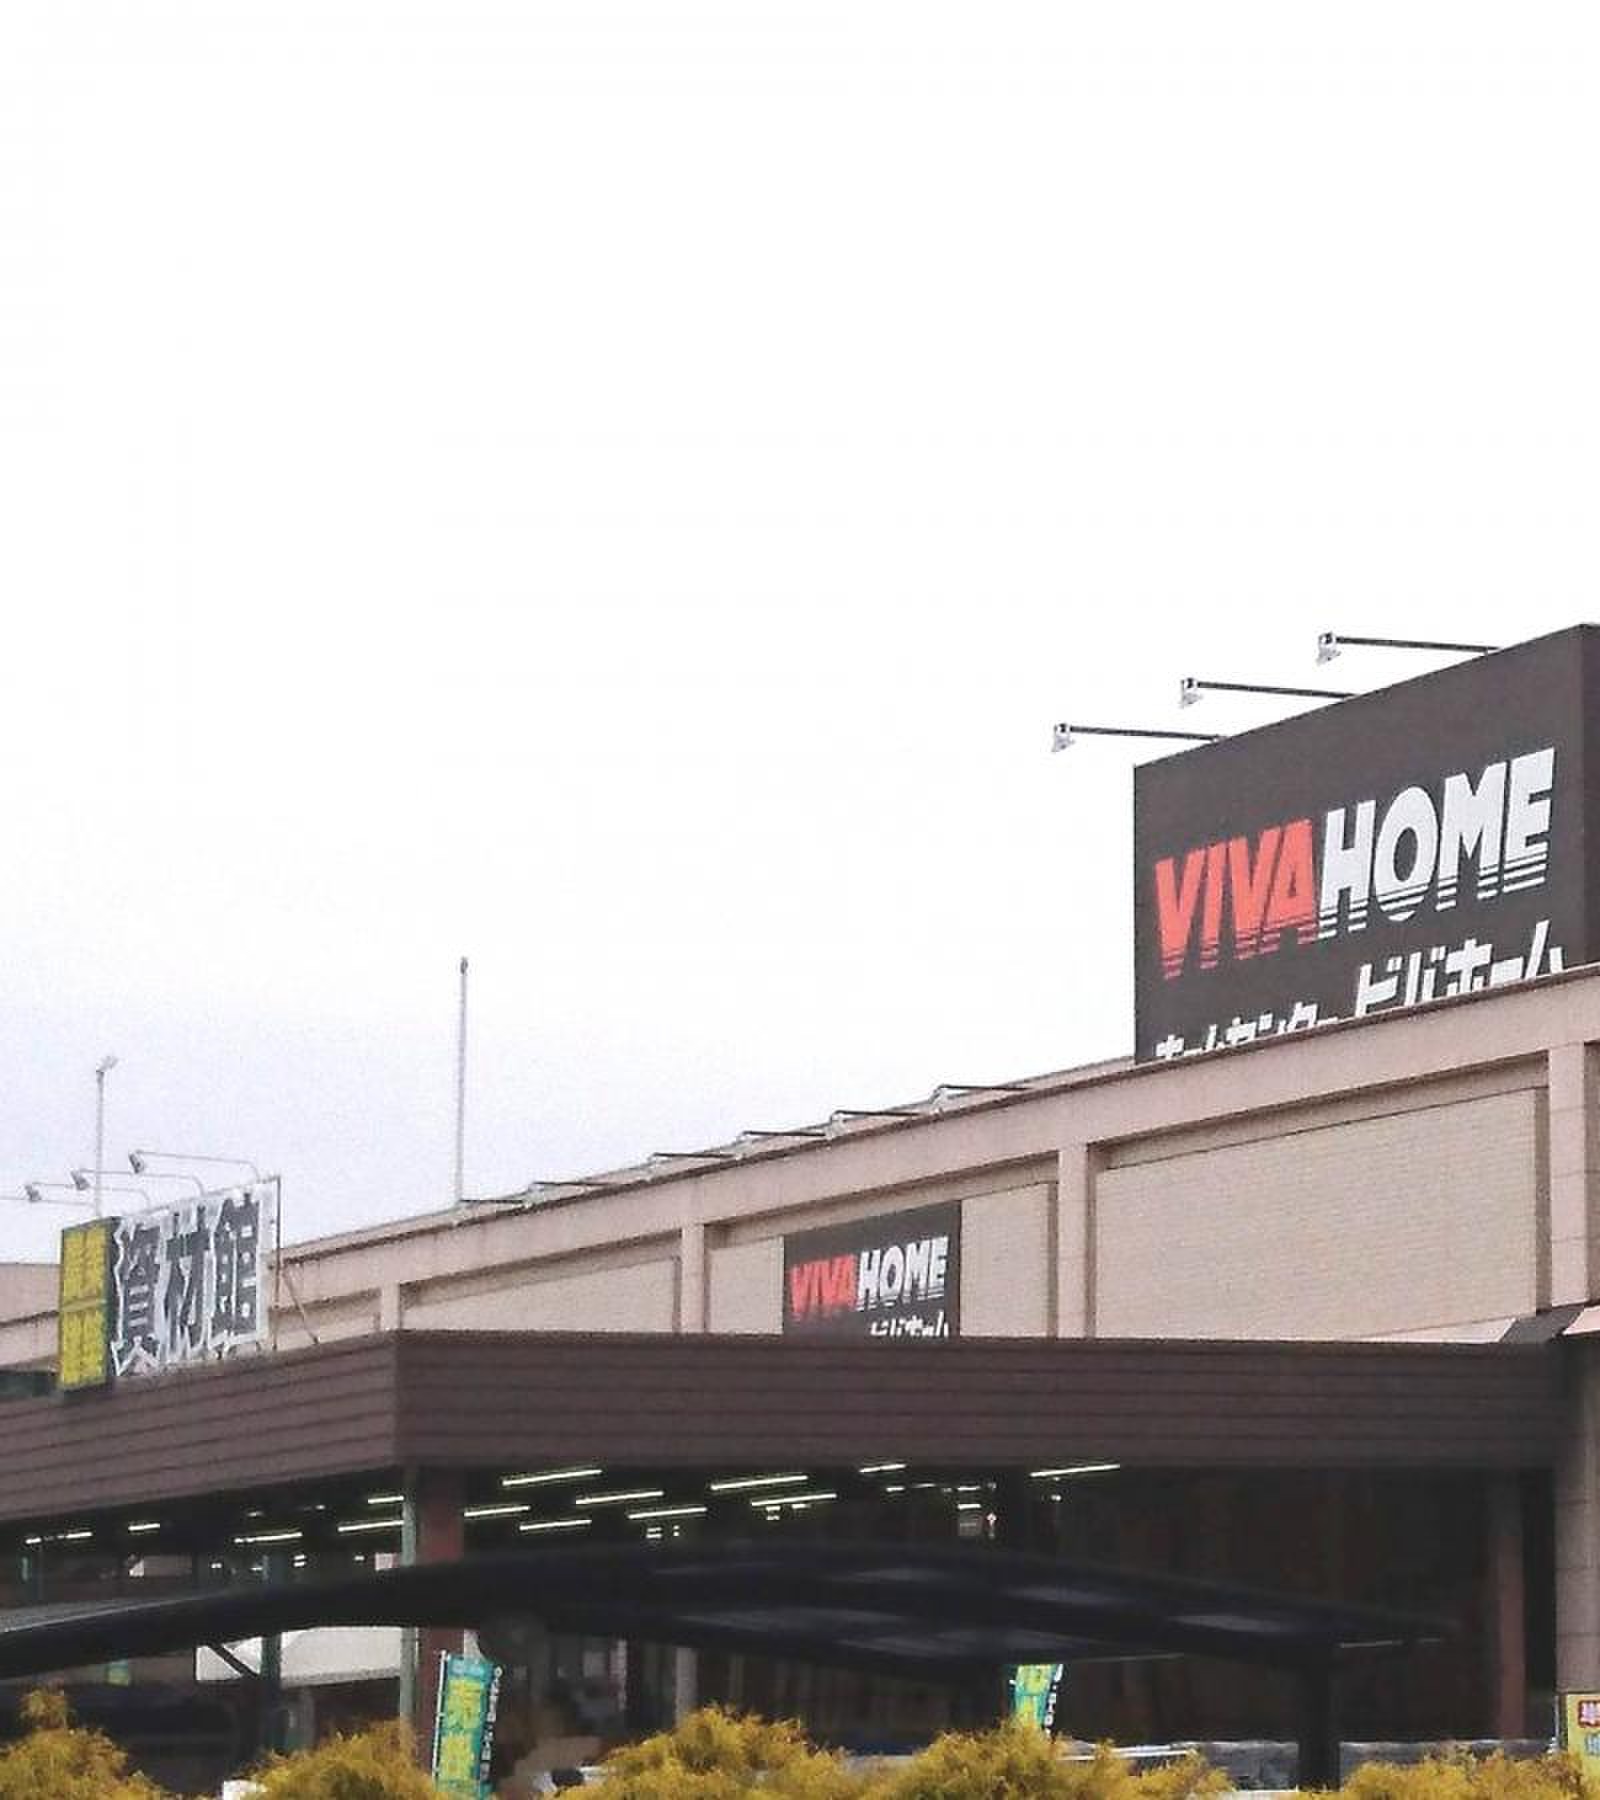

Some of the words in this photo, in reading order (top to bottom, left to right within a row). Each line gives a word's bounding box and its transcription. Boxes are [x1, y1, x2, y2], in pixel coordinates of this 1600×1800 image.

[1155, 747, 1555, 979] VIVAHOME
[113, 1192, 262, 1376] 資材館
[790, 1236, 948, 1321] VIVAHOME
